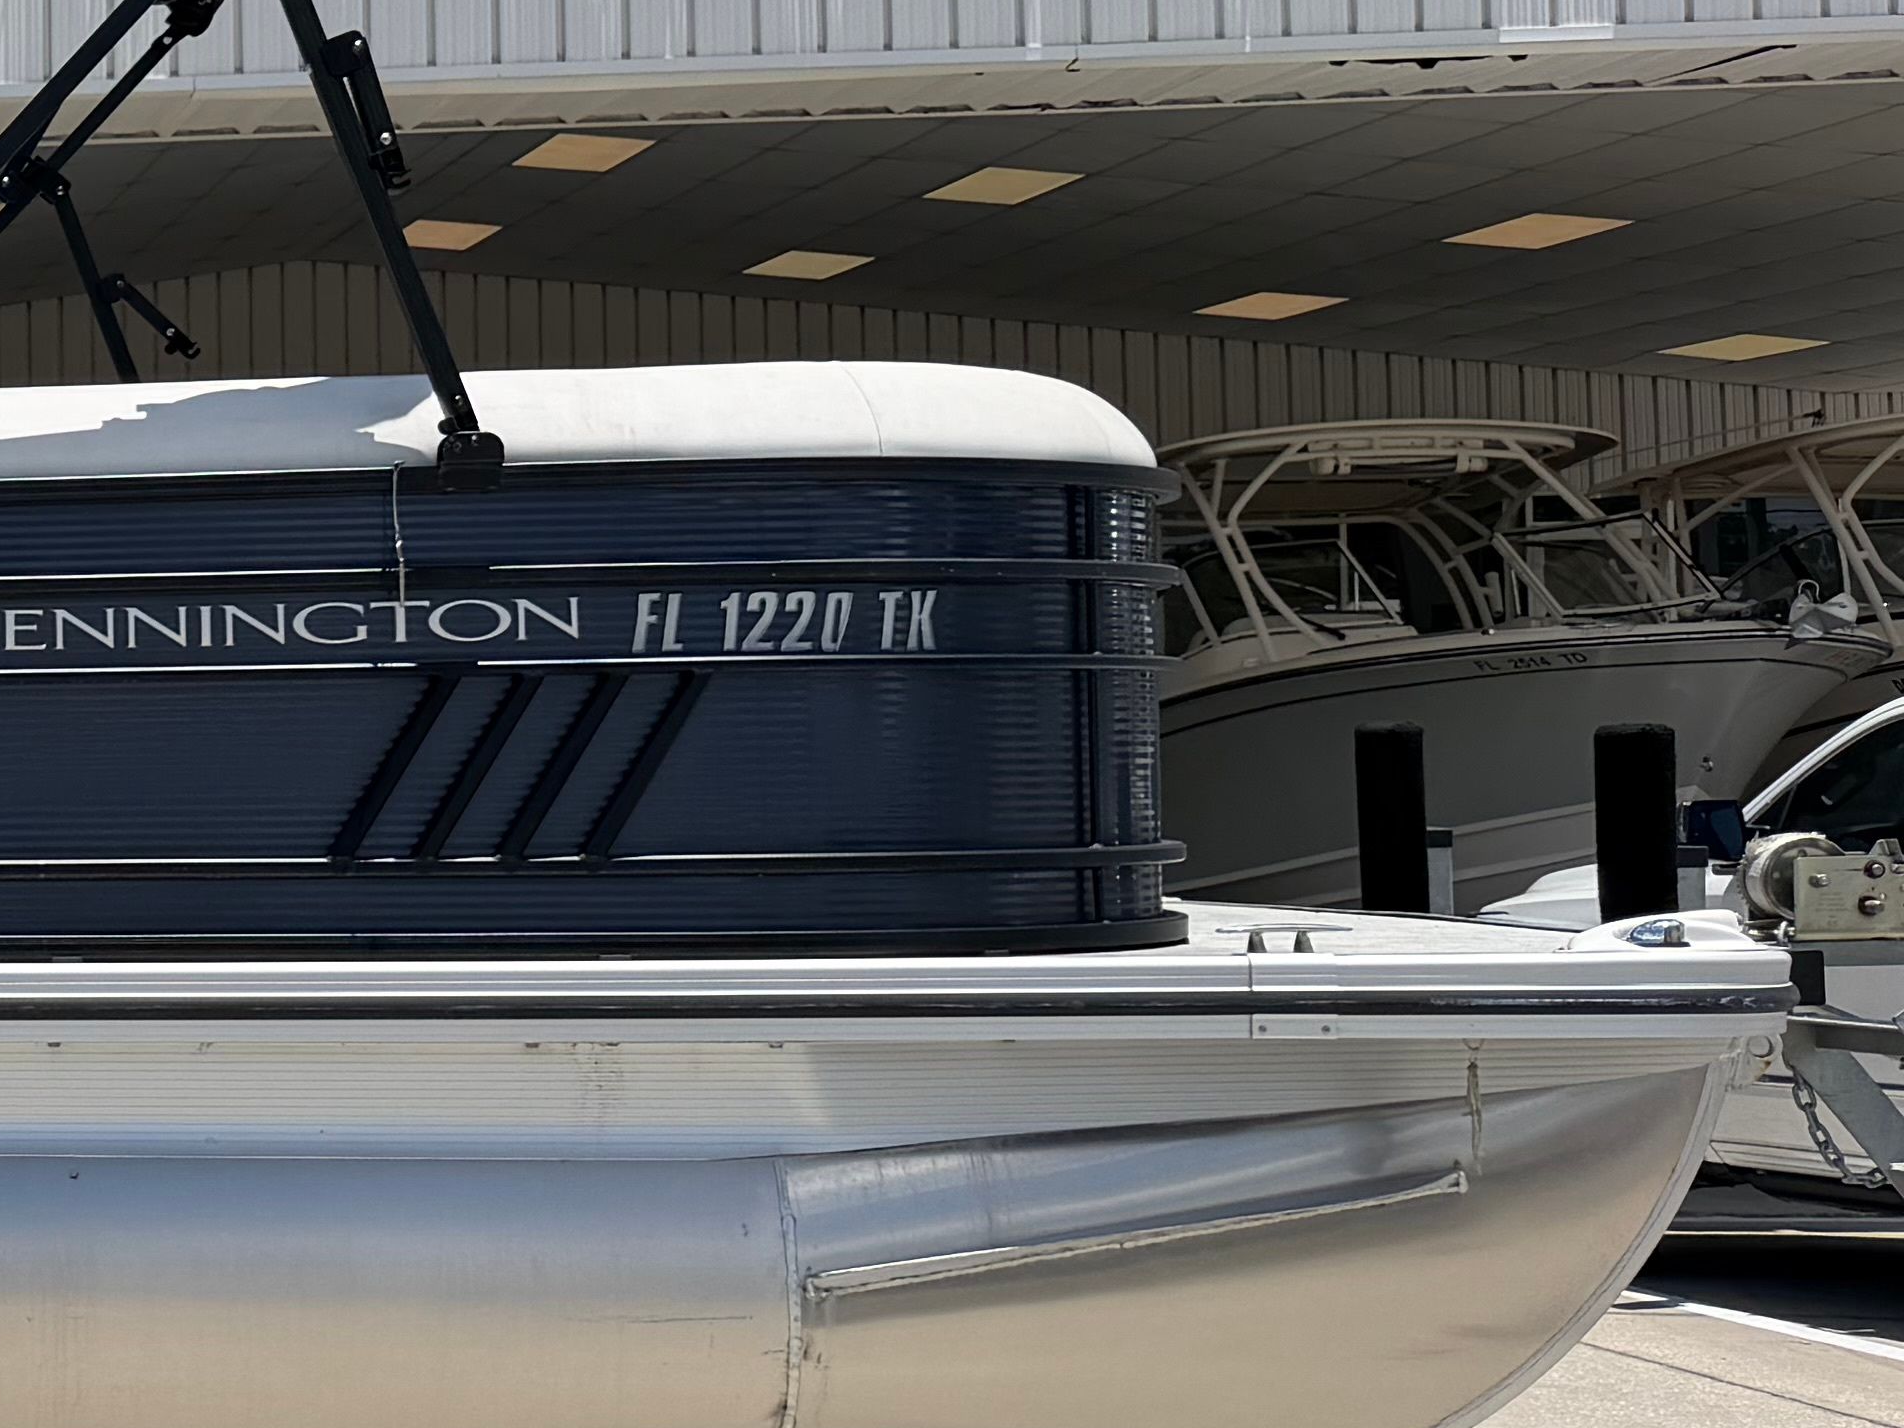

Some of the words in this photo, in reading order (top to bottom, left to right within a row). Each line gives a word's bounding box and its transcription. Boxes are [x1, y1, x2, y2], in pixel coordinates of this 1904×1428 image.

[632, 592, 685, 654] FL
[720, 591, 854, 653] 1220
[879, 589, 938, 652] TK
